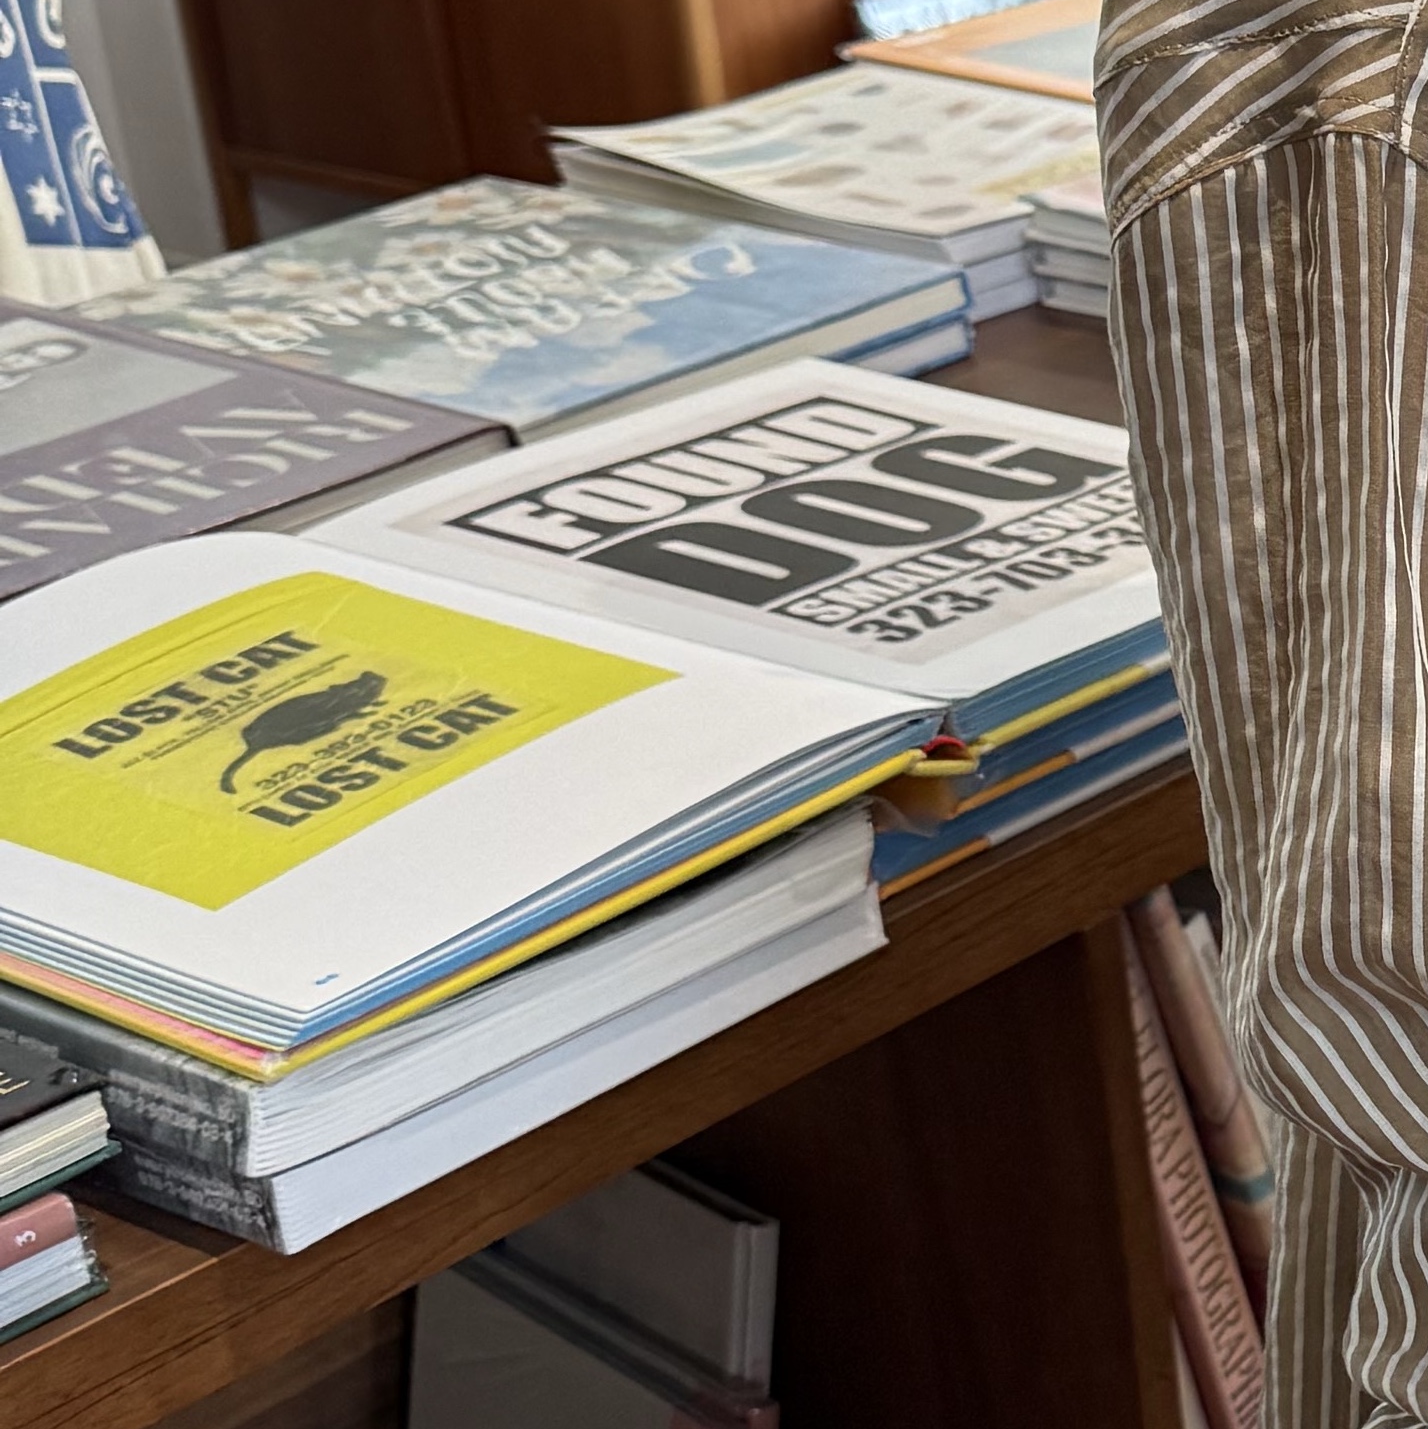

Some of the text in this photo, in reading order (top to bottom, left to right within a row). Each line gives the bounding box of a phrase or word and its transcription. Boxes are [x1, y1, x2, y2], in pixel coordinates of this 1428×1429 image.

[470, 401, 919, 550] FOUND
[578, 434, 1126, 606] DOG
[786, 553, 985, 624] SMALL
[963, 538, 1027, 559] &
[846, 517, 1145, 643] 323-703-3
[51, 682, 209, 759] LOST
[199, 630, 321, 684] CAT
[249, 746, 409, 828] LOST
[398, 692, 521, 752] CAT
